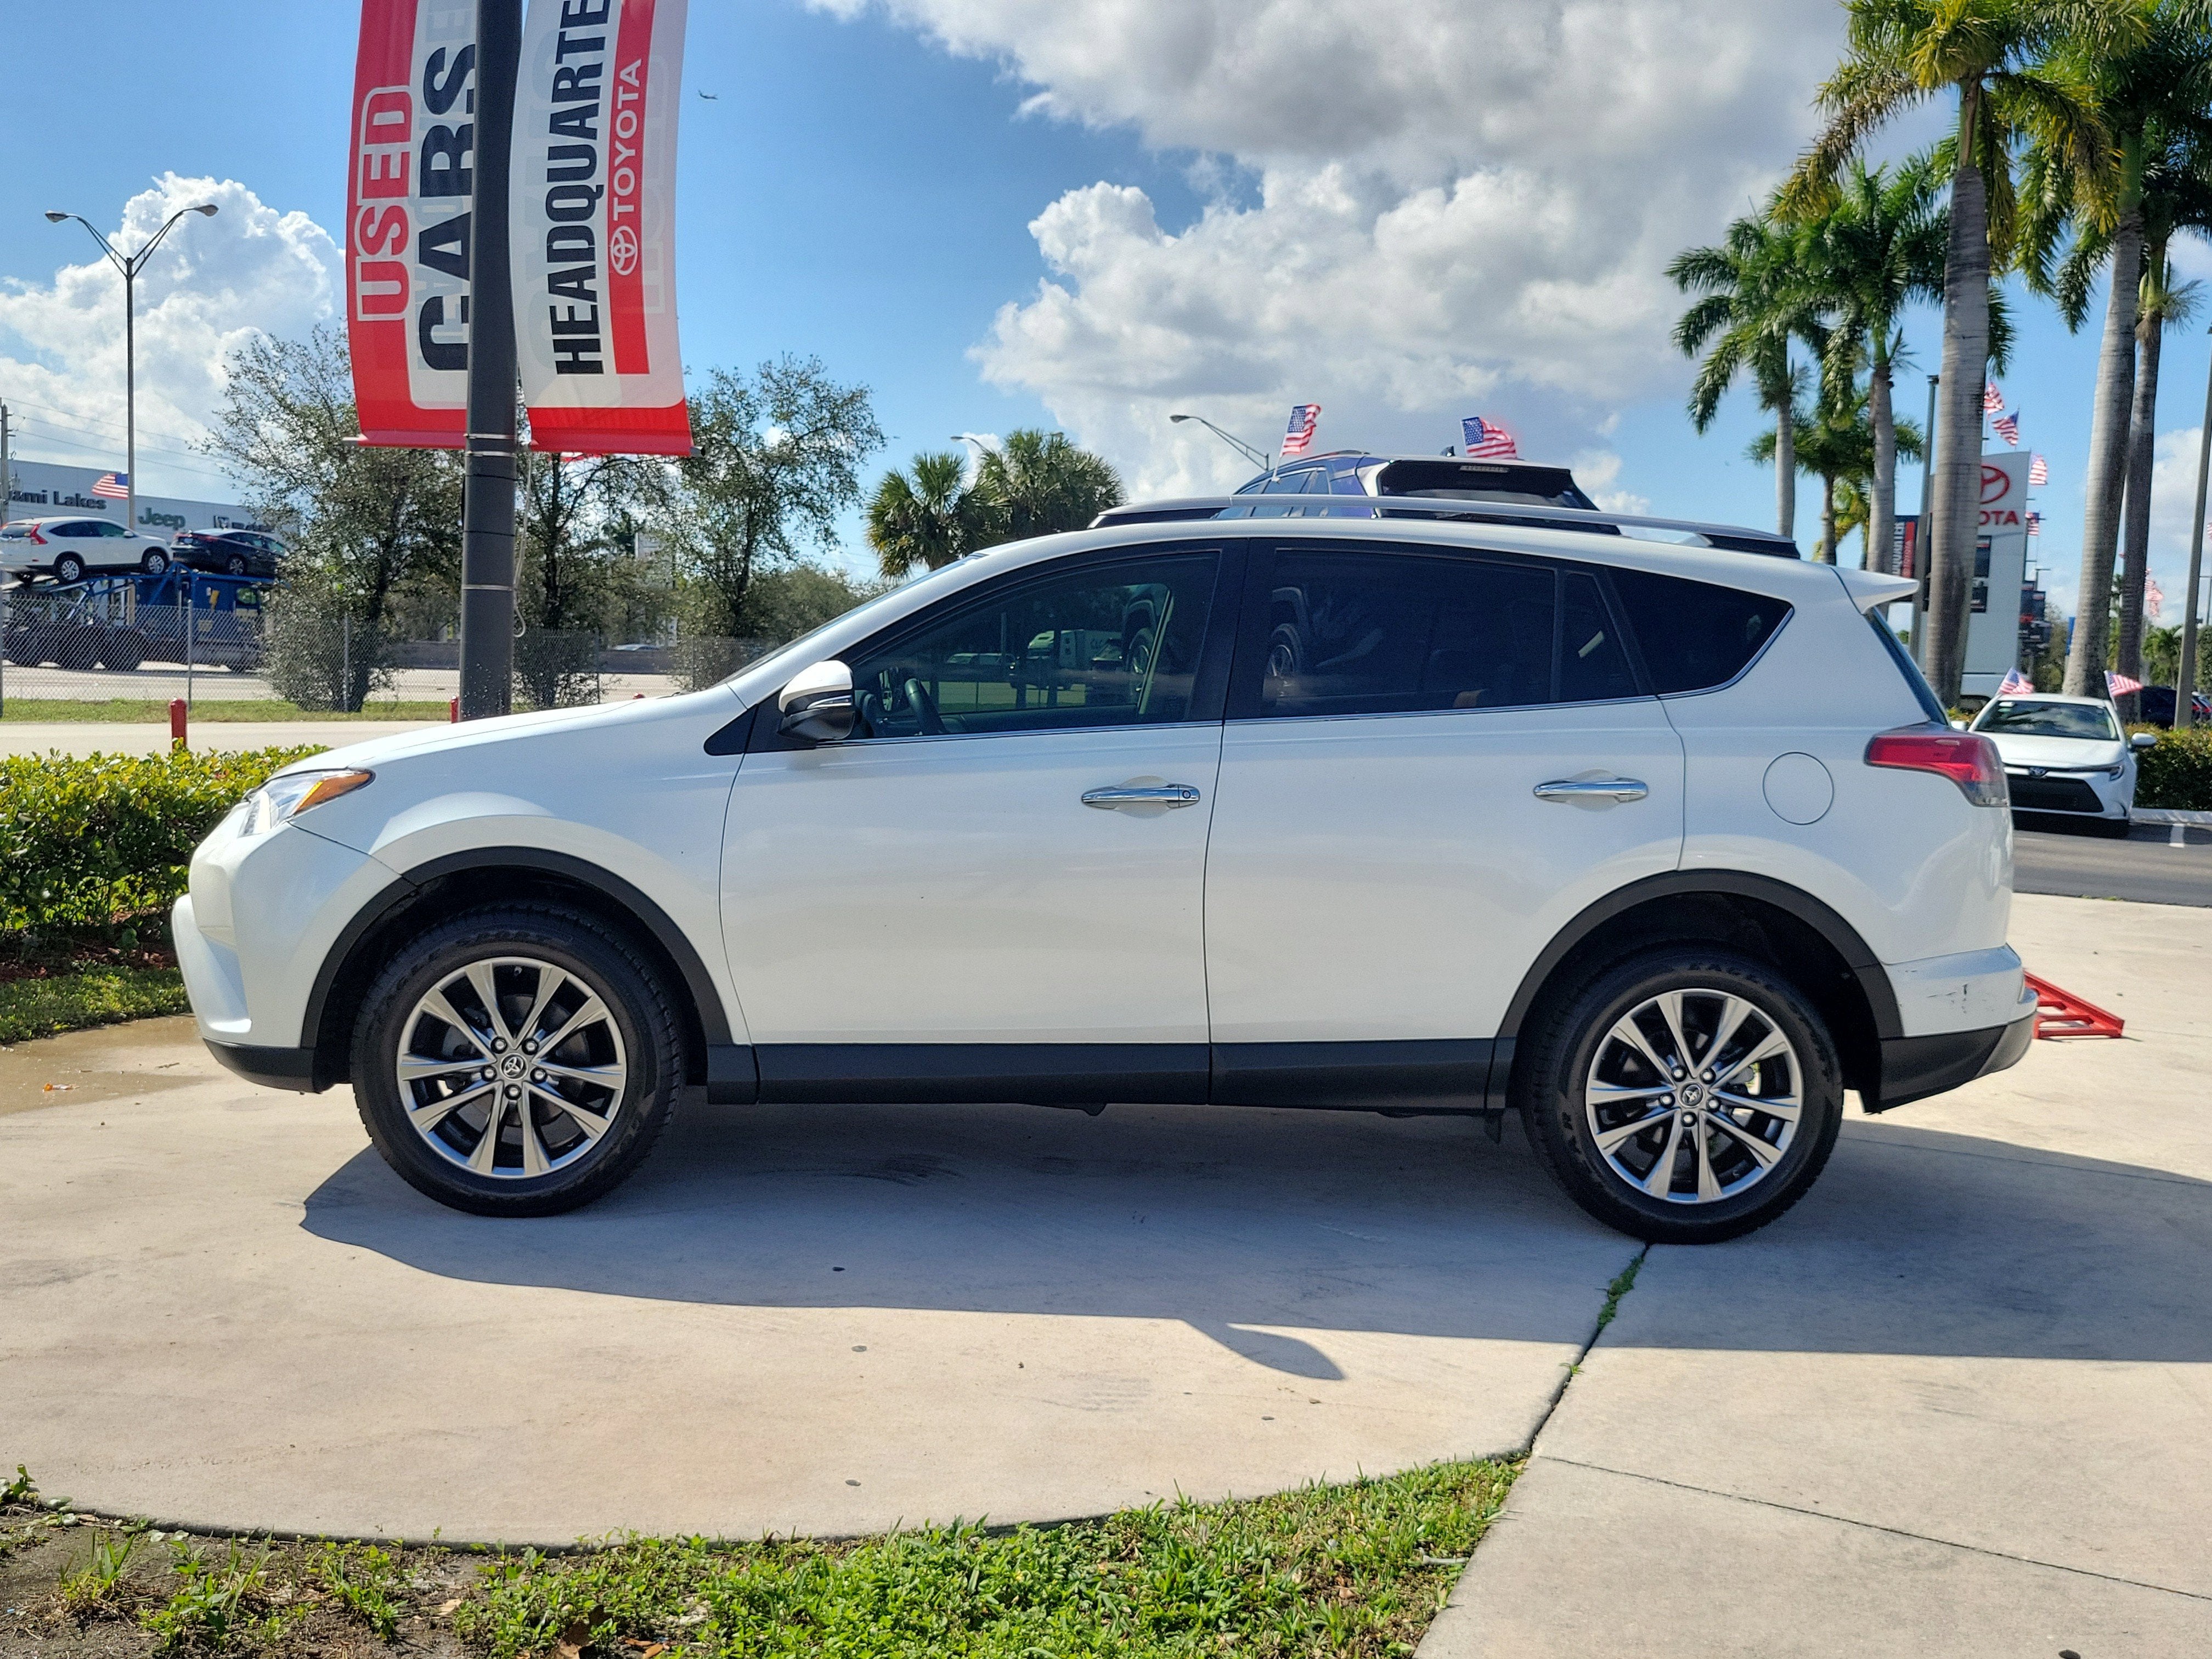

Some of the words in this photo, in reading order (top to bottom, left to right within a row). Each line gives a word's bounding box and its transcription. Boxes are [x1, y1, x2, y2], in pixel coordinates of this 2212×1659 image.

[358, 88, 411, 317] USED
[419, 44, 476, 370] CARS
[612, 59, 642, 221] TOYOTA
[53, 490, 108, 510] Lakes
[138, 507, 186, 531] Jeep
